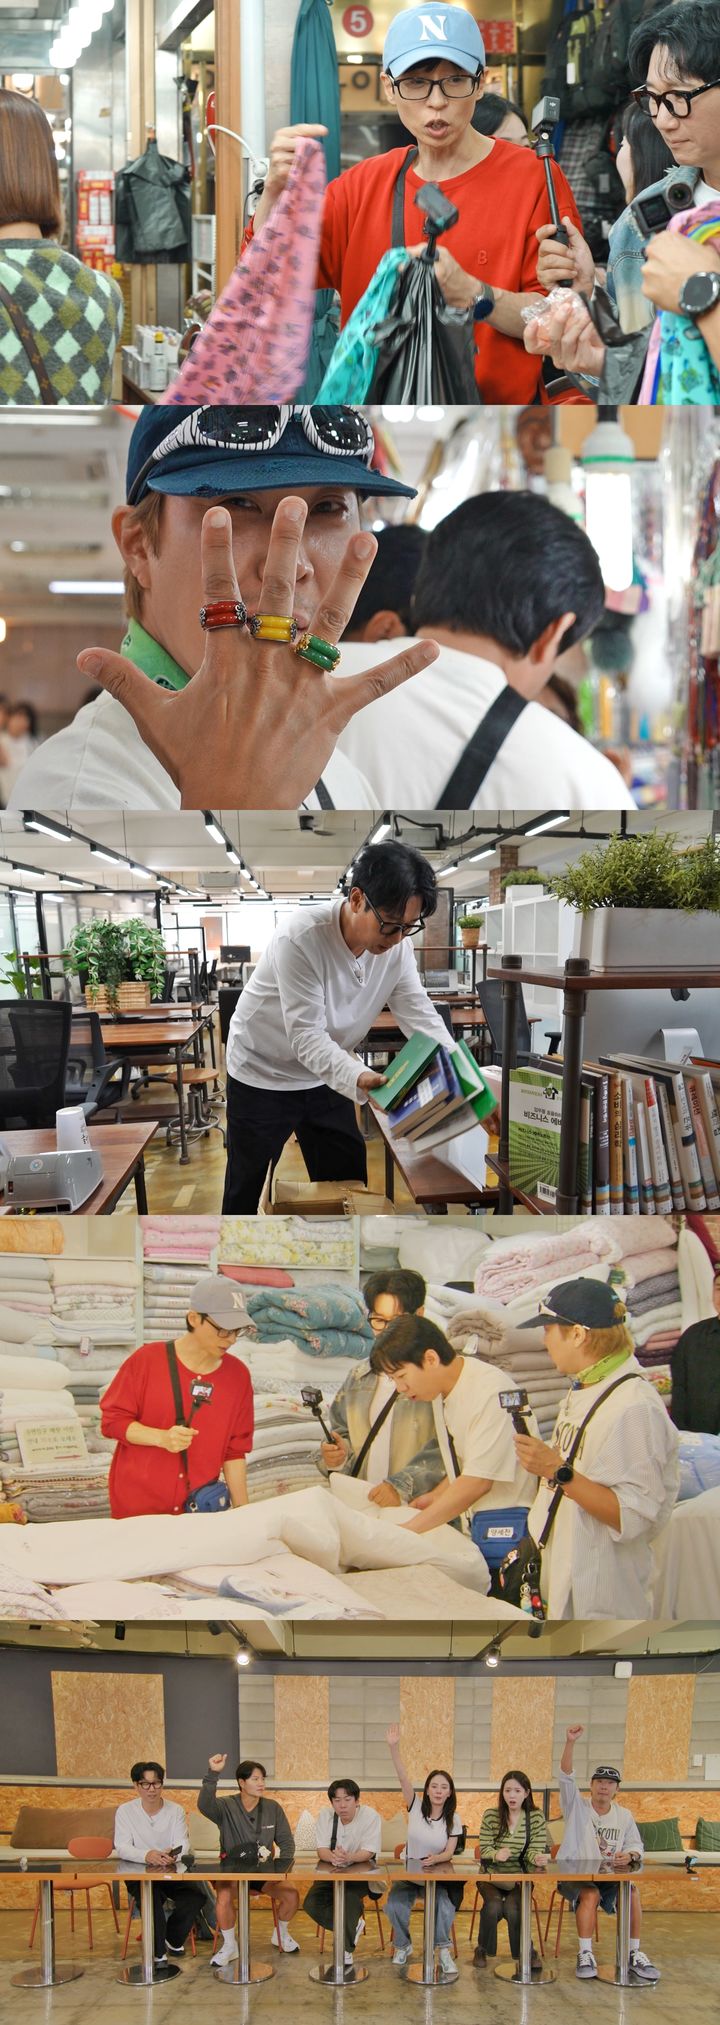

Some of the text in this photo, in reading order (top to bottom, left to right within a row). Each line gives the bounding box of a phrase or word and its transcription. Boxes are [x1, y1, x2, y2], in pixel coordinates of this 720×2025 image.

[350, 10, 367, 33] 5
[417, 15, 448, 41] N
[523, 1109, 549, 1123] 비즈니스
[231, 1292, 245, 1309] N
